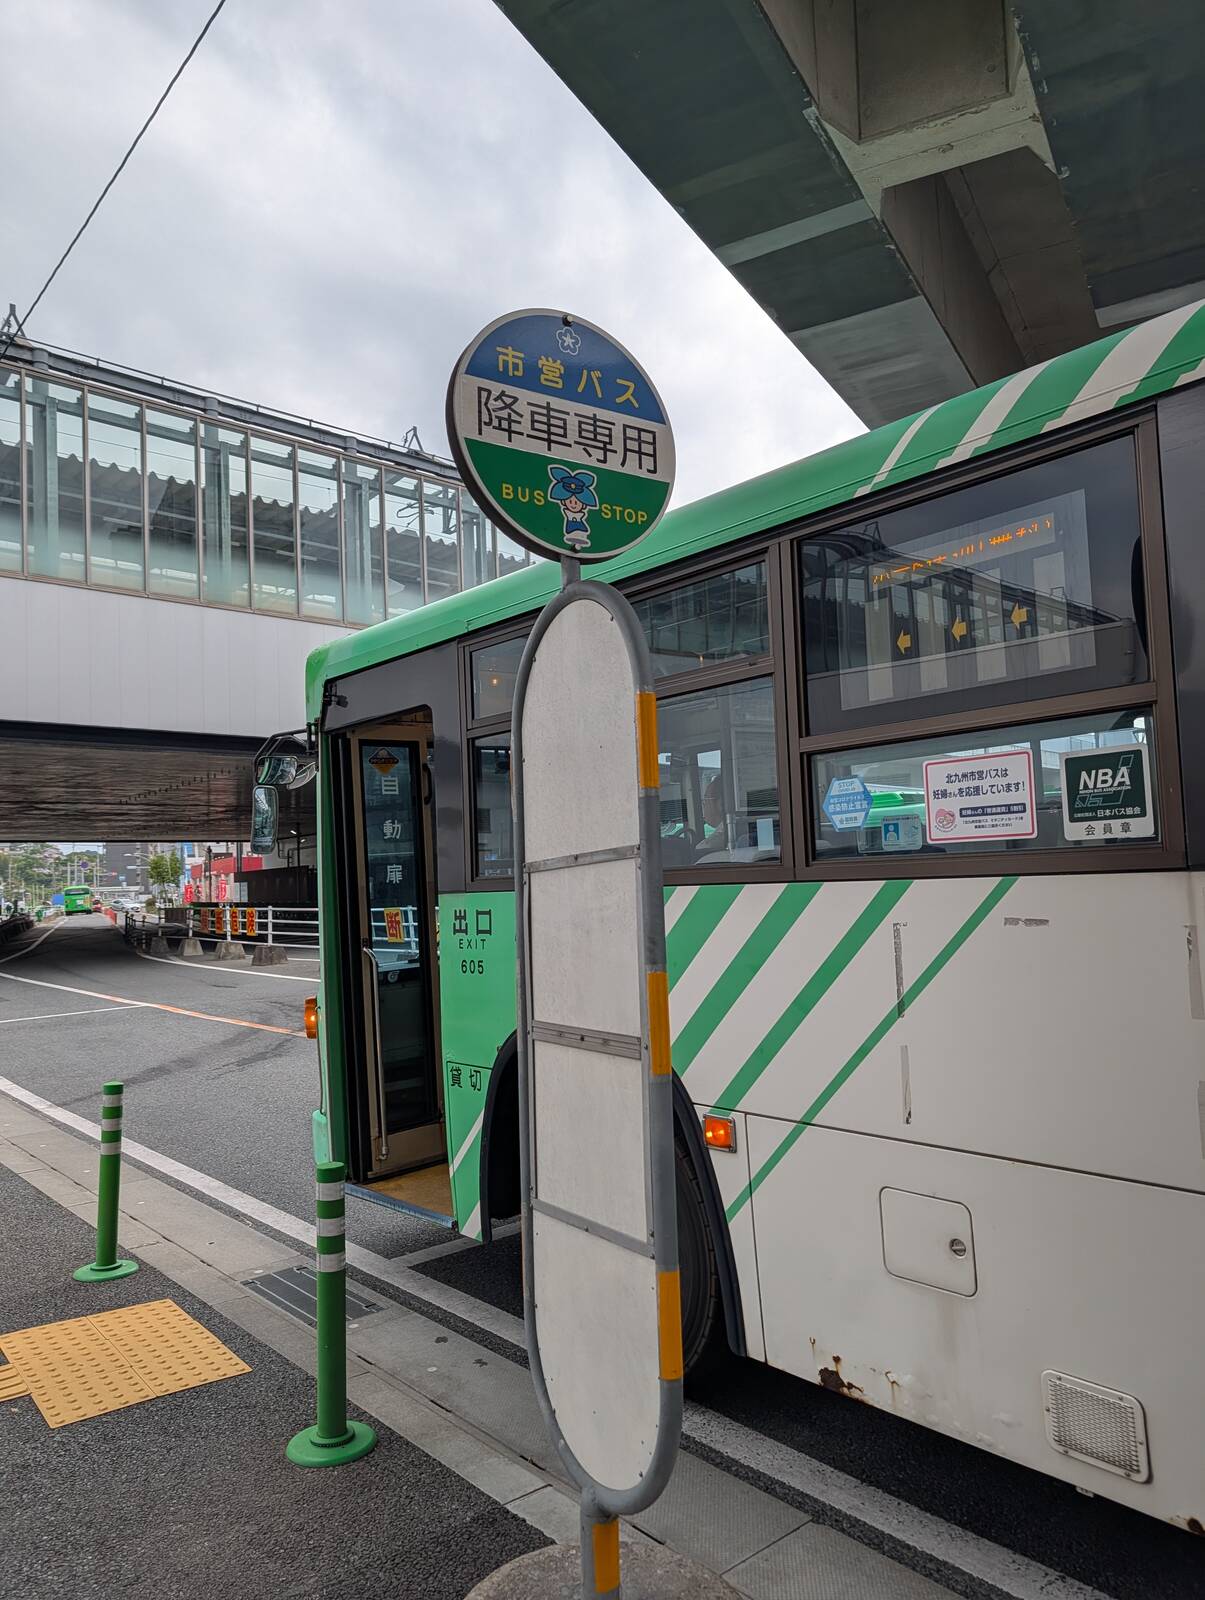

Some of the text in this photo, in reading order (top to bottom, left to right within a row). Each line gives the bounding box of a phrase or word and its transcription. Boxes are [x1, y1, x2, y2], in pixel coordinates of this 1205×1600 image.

[496, 346, 640, 409] 市営バス
[477, 386, 658, 475] 降車専用
[502, 482, 648, 525] BUS STOP
[945, 767, 1010, 784] 北九州市営バスは
[1079, 766, 1132, 790] NBA
[1084, 821, 1132, 836] 会員章
[452, 908, 492, 936] 出口
[458, 938, 487, 950] EXIT
[460, 959, 485, 975] 605
[449, 1066, 482, 1092] 貸切
